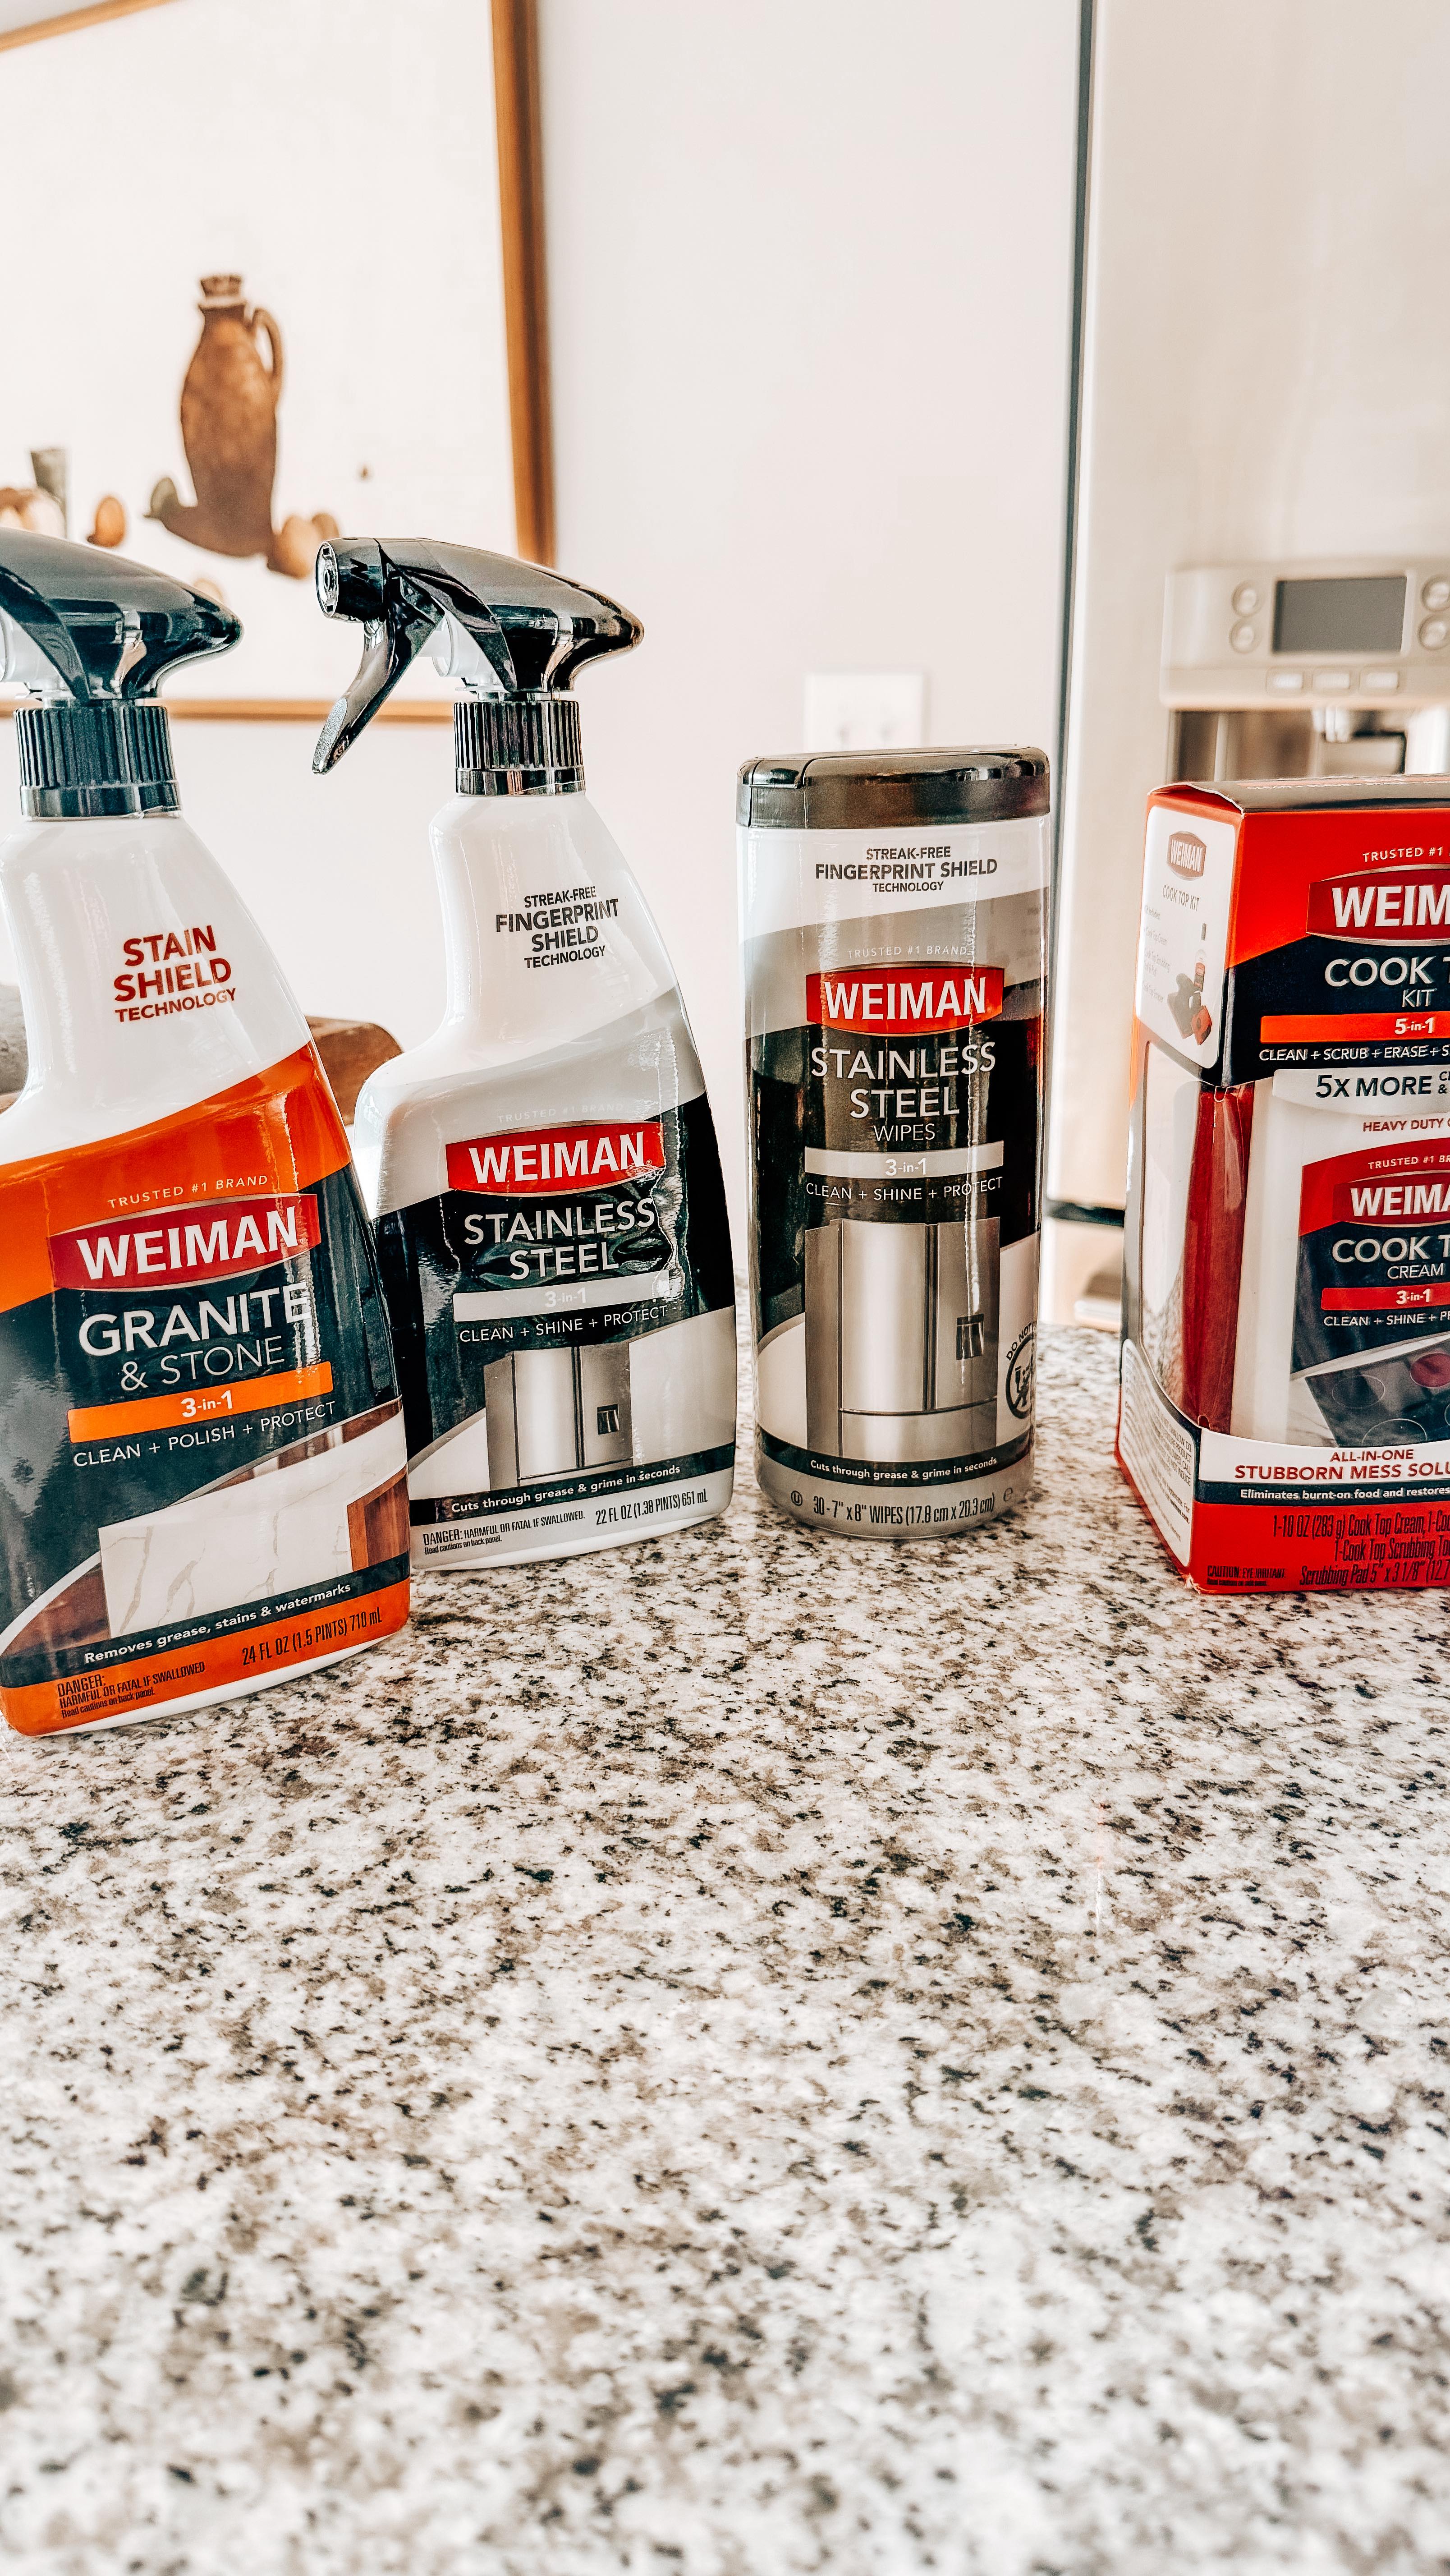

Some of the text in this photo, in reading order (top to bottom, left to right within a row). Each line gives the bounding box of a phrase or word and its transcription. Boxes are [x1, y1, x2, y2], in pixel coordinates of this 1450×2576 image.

[866, 846, 951, 860] STREAK-FREE
[1170, 840, 1202, 872] WEIMAN
[1362, 847, 1442, 862] TRUSTED #1
[815, 859, 997, 880] FINGERPRINT SHIELD
[524, 886, 597, 908] STREAK-FREE
[872, 881, 944, 892] TECHNOLOGY
[1162, 884, 1199, 911] COOK TOP KIT
[496, 898, 619, 933] FINGERPRINT
[123, 925, 216, 966] STAIN
[532, 925, 598, 952] SHIELD
[524, 946, 606, 969] TECHNOLOGY
[848, 946, 967, 958] TRUSTED #1 BRAND
[114, 958, 232, 1002] SHIELD
[1325, 956, 1436, 987] COOK
[115, 988, 236, 1022] TECHNOLOGY
[824, 977, 986, 1020] WEIMAN
[1402, 989, 1436, 1007] KIT
[1395, 1017, 1434, 1035] 5-in-1
[811, 1042, 996, 1079] STAINLESS
[1259, 1045, 1429, 1060] CLEAN SCRUB ERASE
[1356, 1076, 1432, 1097] MORE
[497, 1104, 623, 1123] TRUSTED BRAND
[850, 1087, 959, 1118] STEEL
[873, 1123, 936, 1141] WIPES
[1363, 1120, 1407, 1132] HEAVY
[1411, 1118, 1444, 1129] DUTY
[468, 1132, 644, 1184] WEIMAN
[885, 1158, 927, 1176] 3-in-1
[1368, 1157, 1418, 1169] TRUSTED
[108, 1175, 268, 1209] TRUSTED #1 BRAND
[806, 1177, 1003, 1200] CLEAN SHINE PROTECT
[463, 1198, 655, 1245] STAINLESS
[77, 1207, 297, 1280] WEIMAN
[1332, 1236, 1431, 1263] COOK
[509, 1242, 619, 1280] STEEL
[1387, 1263, 1444, 1279] CREAM
[544, 1288, 587, 1308] 3-in-1
[1396, 1288, 1432, 1305] 3-in-1
[79, 1283, 311, 1356] GRANITE
[459, 1306, 667, 1343] CLEAN SHINE PROTECT
[1324, 1313, 1427, 1326] CLEAN SHINE
[1006, 1322, 1032, 1361] DO NOT
[121, 1336, 284, 1392] & STONE
[181, 1390, 234, 1417] 3-in-1
[73, 1401, 335, 1467] CLEAN POLISH PROTECT
[811, 1460, 830, 1471] Cuts
[832, 1465, 870, 1479] through
[873, 1470, 908, 1480] grease
[922, 1467, 951, 1480] grime
[954, 1466, 962, 1474] in
[964, 1457, 997, 1472] seconds
[1330, 1449, 1414, 1462] ALL-IN-ONE
[1234, 1465, 1343, 1480] STUBBORN
[1350, 1464, 1402, 1479] MESS
[451, 1500, 479, 1513] Cuts
[483, 1492, 531, 1510] through
[535, 1487, 574, 1502] grease
[591, 1477, 623, 1494] grime
[626, 1474, 636, 1483] in
[639, 1465, 680, 1481] seconds
[1241, 1488, 1450, 1500] Eliminates burnt-on food and restores
[596, 1489, 708, 1525] 22 FL OZ (1.38 PINTS) 651 mL
[813, 1493, 995, 1526] 30 8" WIPES (17.8 cm x 20.3 cm)
[423, 1510, 585, 1546] DANGER: HARMFUL OR FATAL IF SWALLOWED.
[1273, 1512, 1425, 1540] 1-10 OZ (283 g) Cook Top Cream,
[425, 1546, 439, 1555] Read
[440, 1543, 462, 1552] cautions
[471, 1537, 485, 1546] back
[486, 1535, 502, 1545] panel.
[1335, 1536, 1435, 1562] 1-Cook Top Scrubbing
[1242, 1568, 1253, 1578] EYE
[1299, 1564, 1390, 1587] Scrubbing Pad x
[85, 1583, 351, 1664] Removes grease, stains & watermarks
[243, 1606, 383, 1665] 24 FL OZ (1.5 PINTS) 710 mL
[57, 1674, 105, 1697] DANGER:
[59, 1661, 205, 1709] HARMFUL OR FATAL IF SWALLOWED
[62, 1707, 79, 1718] Read
[80, 1701, 108, 1713] cautions
[118, 1693, 134, 1704] back
